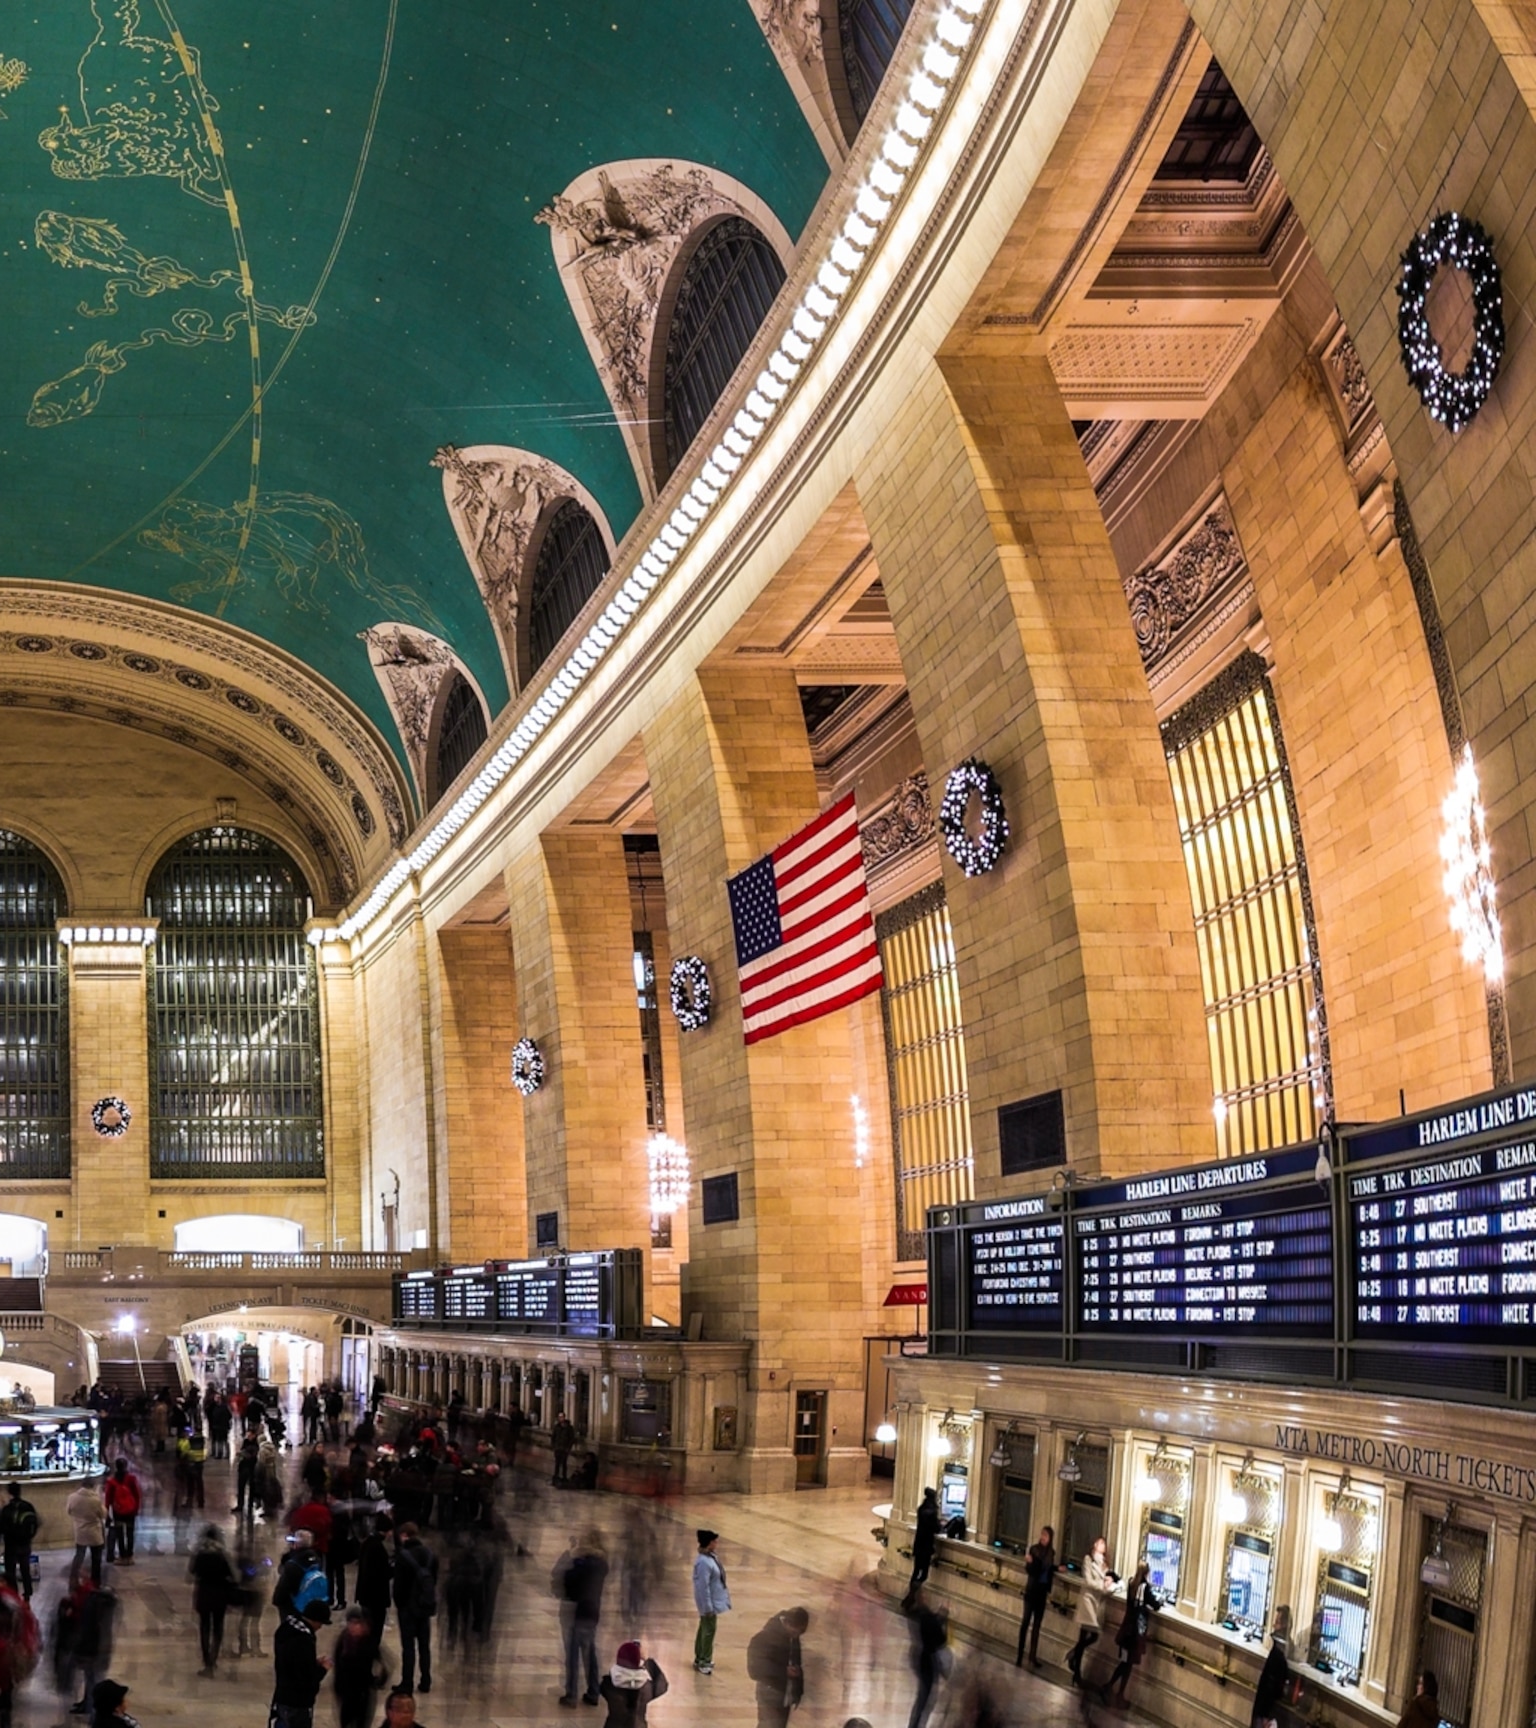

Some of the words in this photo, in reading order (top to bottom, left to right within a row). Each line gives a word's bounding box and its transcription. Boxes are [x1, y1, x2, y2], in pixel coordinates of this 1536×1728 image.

[1419, 1108, 1478, 1146] HARLEM
[1480, 1097, 1515, 1130] LINE
[1126, 1178, 1169, 1200] HARLEM
[1171, 1173, 1196, 1193] LINE
[1198, 1160, 1267, 1189] DEPARTURES
[1352, 1177, 1377, 1196] TIME
[1383, 1172, 1406, 1192] TRK
[1411, 1155, 1481, 1186] DESTINATION
[1414, 1192, 1457, 1215] SOUTHEAST
[1500, 1179, 1526, 1201] WHITE
[984, 1199, 1044, 1220] INFORMATION
[1077, 1220, 1096, 1232] TIME
[1100, 1218, 1117, 1230] TRK
[1120, 1210, 1171, 1228] DESTINATION
[1181, 1203, 1222, 1221] REMARKS
[1429, 1220, 1454, 1241] WHITE
[1457, 1215, 1488, 1238] PLAINS
[1256, 1240, 1274, 1256] STOP
[1415, 1248, 1459, 1269] SOUTHEAST
[1238, 1264, 1255, 1279] STOP
[1358, 1280, 1381, 1297] 10:25
[1430, 1276, 1455, 1296] WHITE
[1458, 1274, 1488, 1294] PLAINS
[1238, 1306, 1255, 1321] STOP
[1416, 1304, 1460, 1323] SOUTHEAST
[1502, 1304, 1529, 1323] WHITE
[1275, 1425, 1310, 1452] MTA
[1315, 1431, 1451, 1481] METRO-NORTH
[1456, 1455, 1535, 1502] TICKETS
